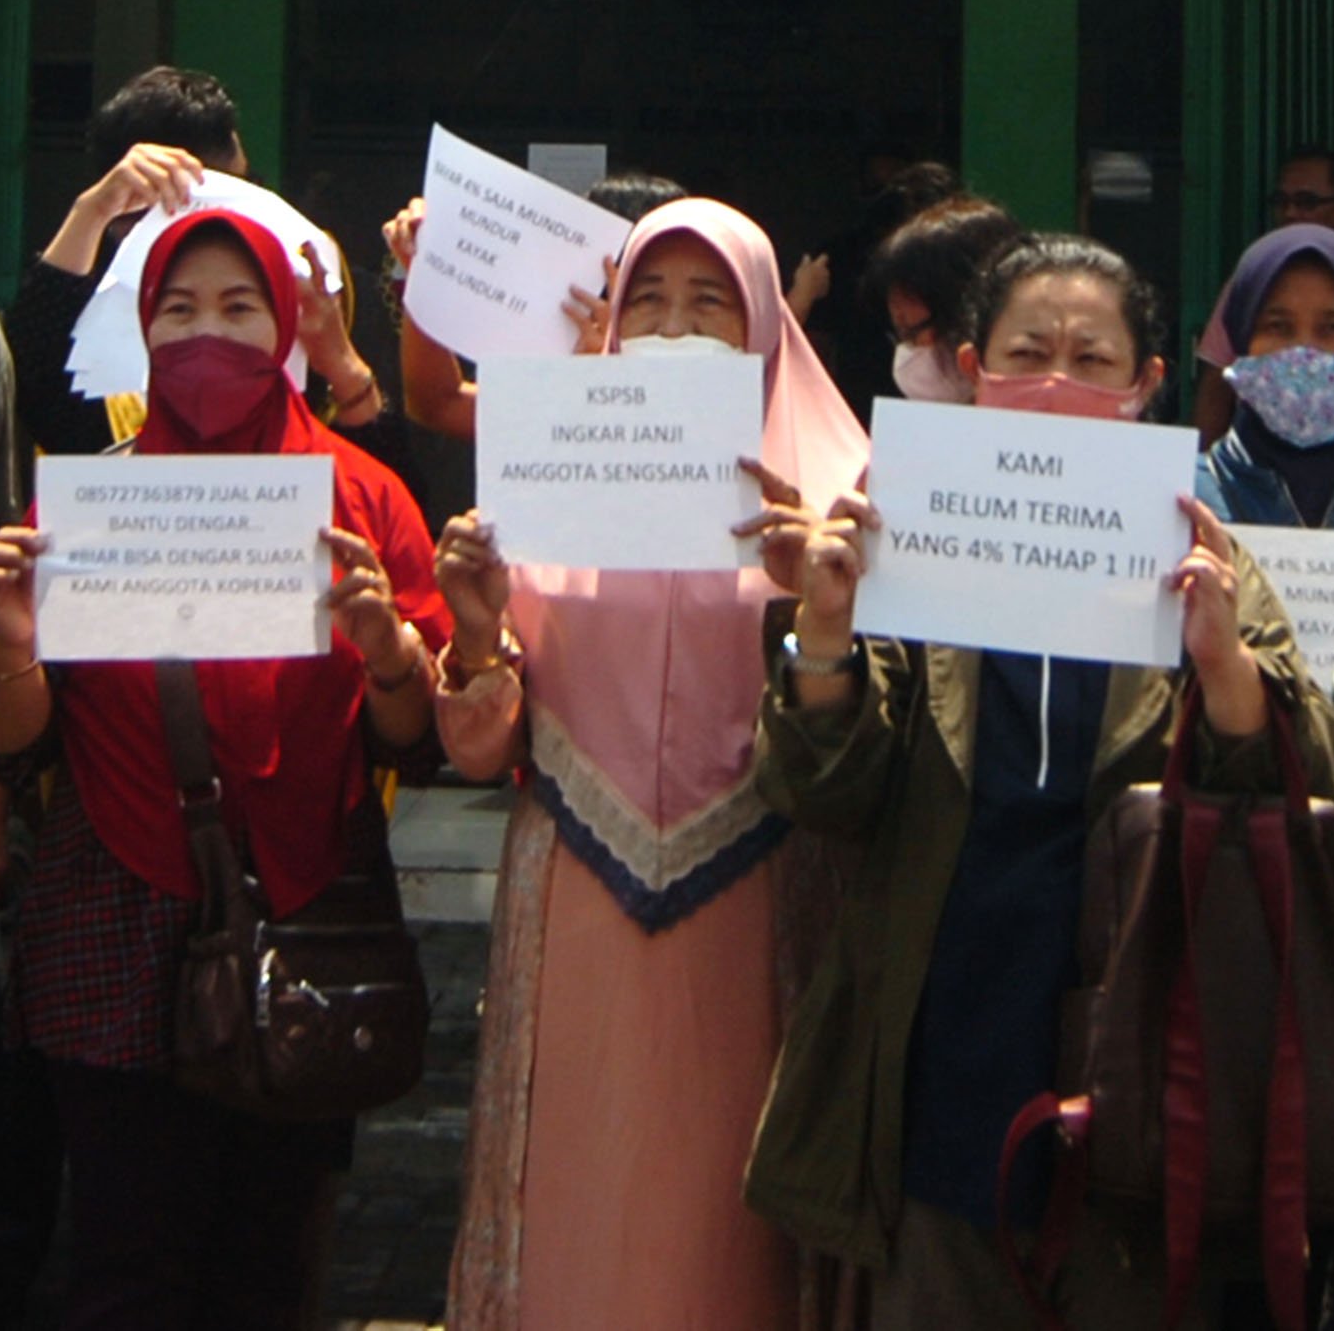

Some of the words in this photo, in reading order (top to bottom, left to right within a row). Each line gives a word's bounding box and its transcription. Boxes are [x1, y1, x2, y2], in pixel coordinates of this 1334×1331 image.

[458, 205, 522, 246] MUNDUR
[482, 187, 516, 215] SAJA
[515, 203, 591, 249] MUNDUR-
[456, 236, 499, 268] KAYAK
[586, 386, 647, 406] KSPSB
[551, 424, 626, 444] INGKAR
[631, 424, 684, 444] JANJI
[500, 463, 596, 483] ANGGOTA
[601, 463, 710, 483] SENGSARA
[996, 449, 1065, 478] KAMI
[208, 485, 251, 503] JUAL
[254, 484, 299, 502] ALAT
[929, 490, 1018, 522] BELUM
[1026, 500, 1125, 533] TERIMA
[108, 515, 168, 533] BANTU
[123, 548, 164, 565] BISA
[166, 548, 242, 565] DENGAR
[247, 547, 306, 564] SUARA
[889, 529, 960, 559] YANG
[966, 538, 1004, 564] 4%
[1012, 542, 1098, 574] TAHAP
[1106, 553, 1118, 577] 1
[1128, 555, 1157, 580] !!!
[69, 577, 117, 594] KAMI
[121, 577, 212, 595] ANGGOTA
[217, 576, 303, 594] KOPERASI
